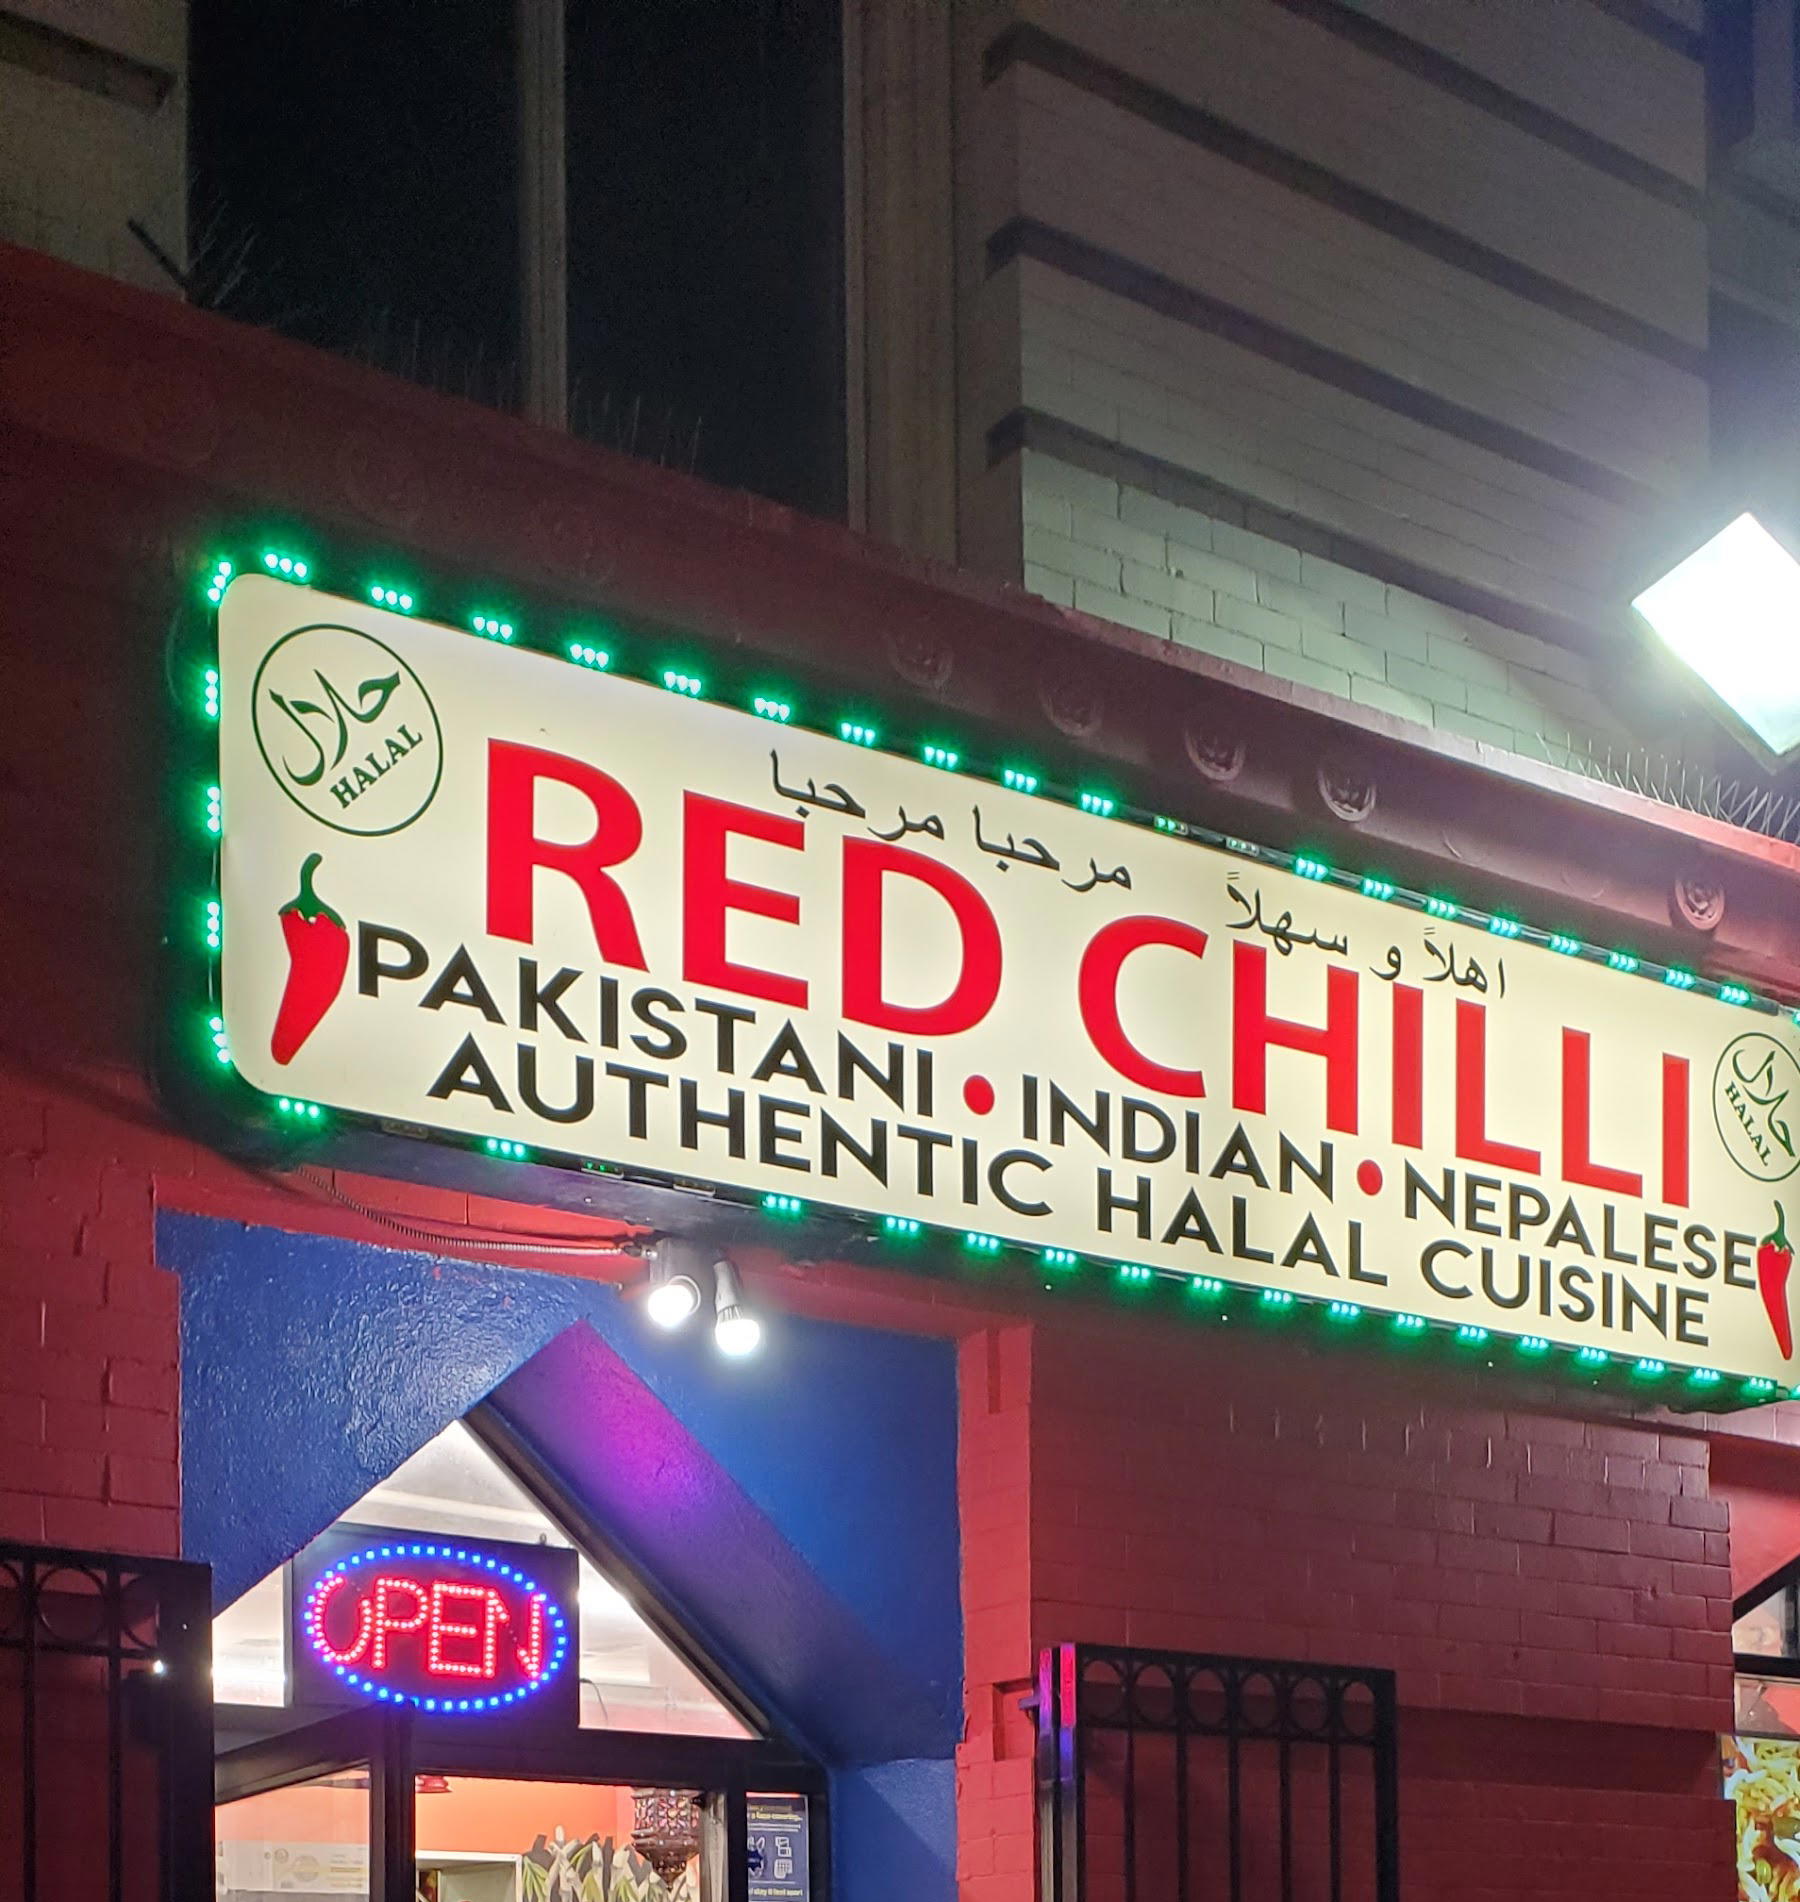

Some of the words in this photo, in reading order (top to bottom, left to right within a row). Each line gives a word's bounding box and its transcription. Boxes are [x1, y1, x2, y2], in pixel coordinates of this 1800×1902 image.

[329, 724, 423, 809] HALAL
[770, 748, 945, 841] مرحبا
[972, 804, 1132, 893] مرحبا
[486, 737, 1003, 1037] RED
[1078, 914, 1690, 1209] CHILLI
[1369, 944, 1401, 981] و
[356, 920, 934, 1119] PAKISTANI
[1022, 1074, 1334, 1204] INDIAN
[1405, 1160, 1757, 1290] NEPALESE
[1724, 1080, 1771, 1167] HALAL
[426, 1031, 1053, 1217] AUTHENTIC
[1098, 1167, 1388, 1288] HALAL
[1420, 1239, 1709, 1346] CUISINE
[313, 1576, 547, 1681] OPEN
